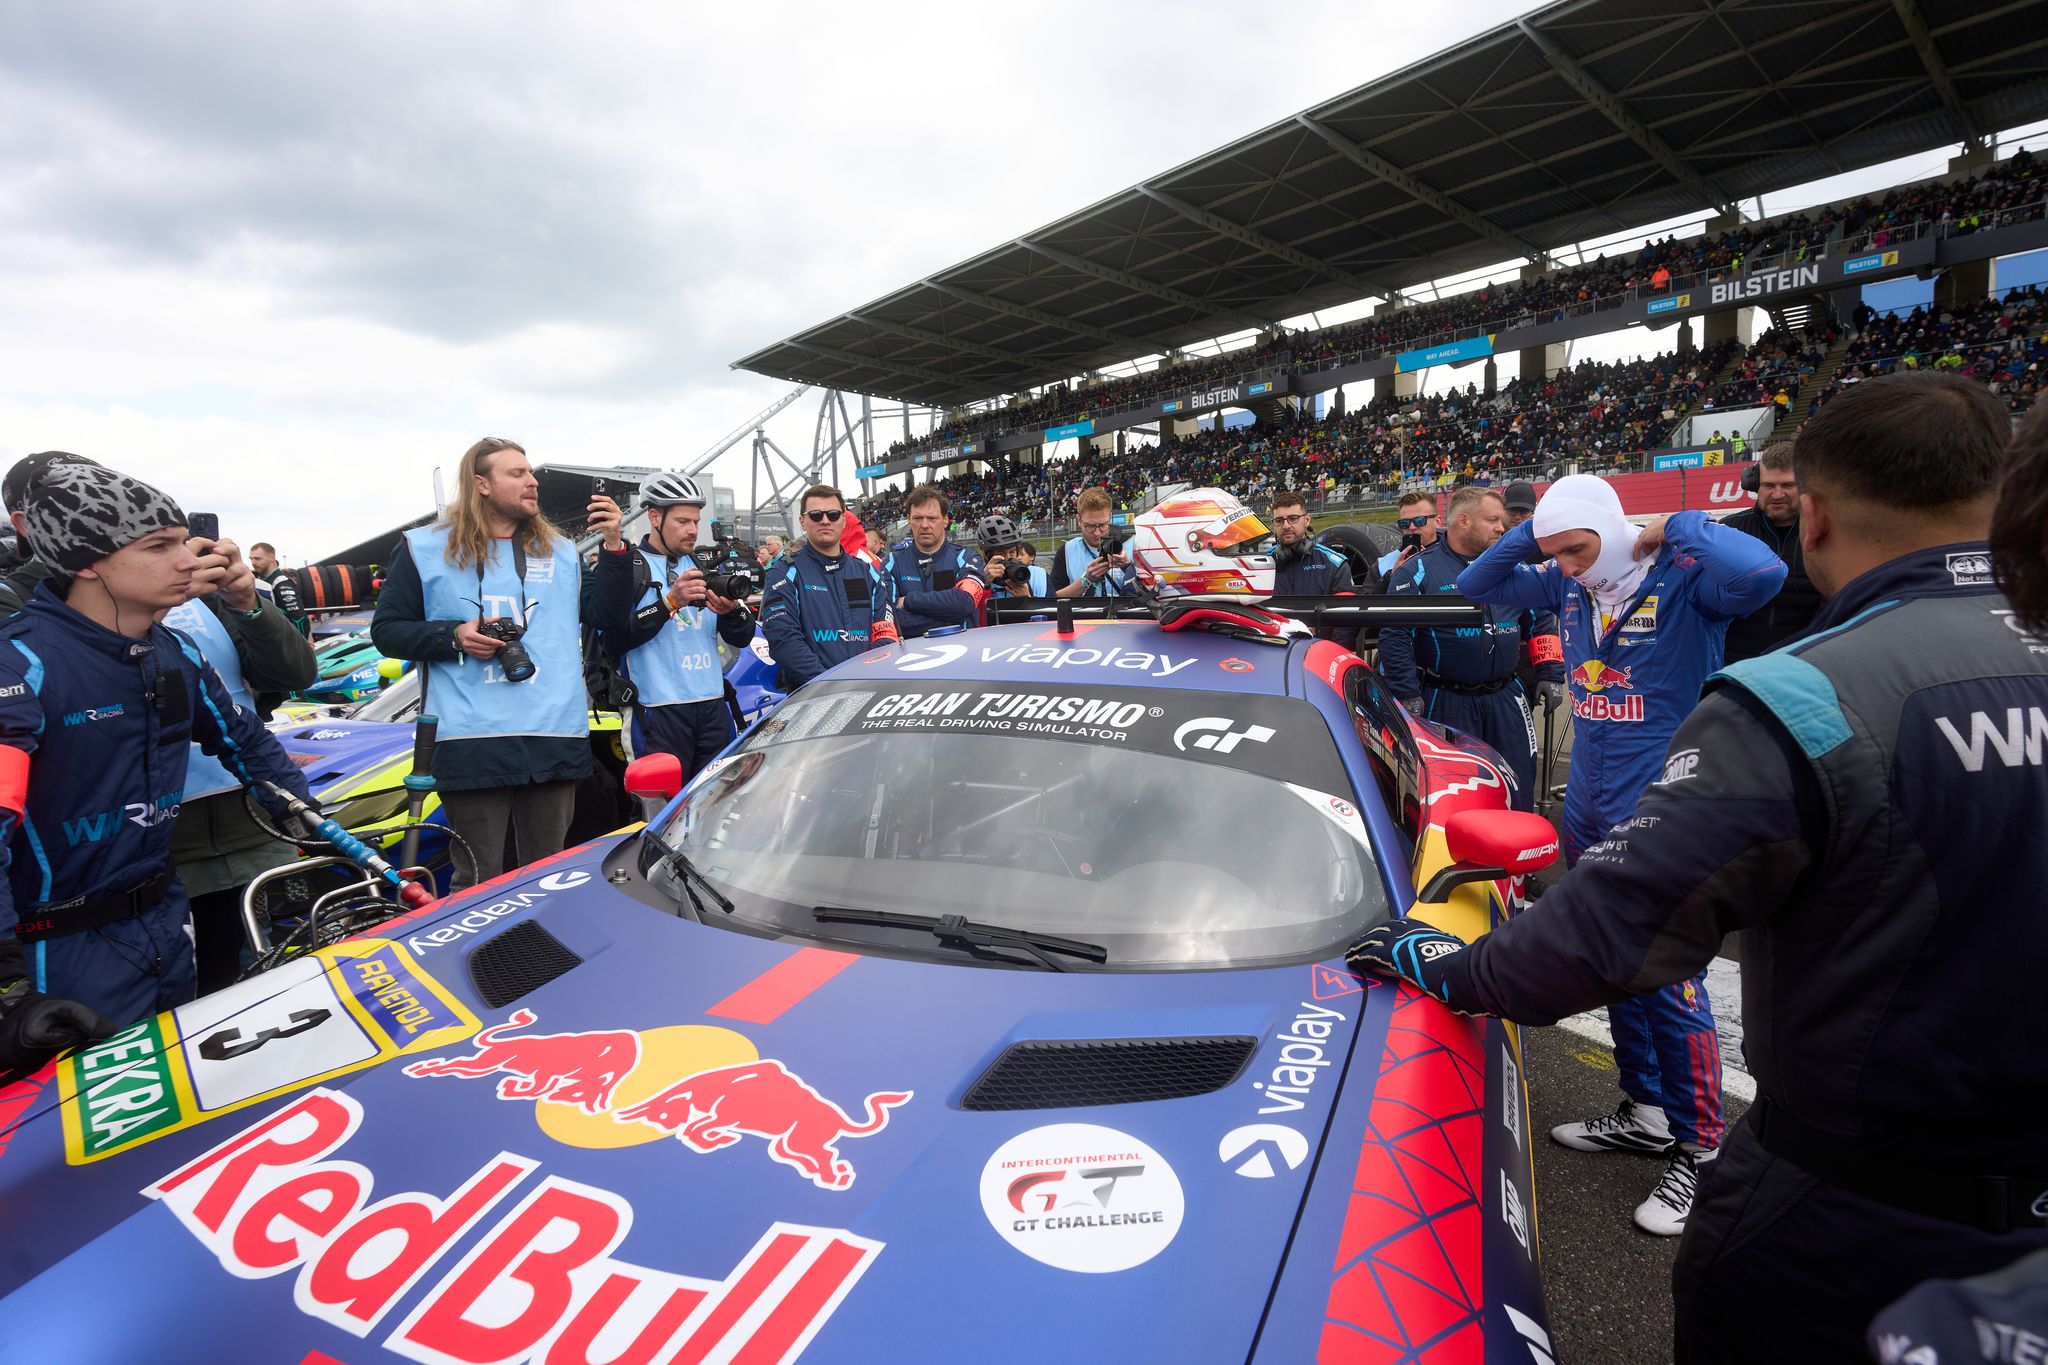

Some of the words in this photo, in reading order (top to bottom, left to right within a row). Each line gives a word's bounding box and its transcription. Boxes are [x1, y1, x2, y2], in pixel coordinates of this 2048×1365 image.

[1848, 258, 1879, 271] BILSTEIN
[1711, 264, 1819, 304] BILSTEIN
[1651, 300, 1675, 311] BILSTEIN
[1191, 387, 1239, 409] BILSTEIN
[931, 447, 959, 461] BILSTEIN
[1659, 457, 1698, 469] BILSTEIN
[1228, 580, 1245, 588] BELL
[681, 652, 712, 671] 420
[977, 643, 1199, 678] viaplay
[1538, 644, 1552, 652] 24h
[867, 692, 971, 718] GRAN
[1568, 690, 1592, 719] Red
[1590, 694, 1644, 722] Bull
[861, 719, 893, 730] THE
[895, 718, 937, 729] REAL
[939, 718, 1012, 732] DRIVING
[1015, 721, 1127, 742] SIMULATOR
[1521, 699, 1537, 751] RAVENOL
[1662, 754, 1699, 782] OMP
[15, 919, 55, 934] EDEL
[409, 891, 548, 957] viaplay
[354, 958, 434, 1034] RAVENOL
[198, 1007, 332, 1061] 3
[1253, 1001, 1346, 1115] viaplay
[79, 1022, 171, 1151] DEKRA
[1506, 1064, 1517, 1136] RAVENOL
[1001, 1152, 1143, 1169] INTERCONTINENTAL
[1007, 1165, 1145, 1213] GT
[1013, 1219, 1039, 1232] GT
[1045, 1210, 1164, 1230] CHALLENGE
[1505, 1177, 1528, 1249] OMP
[145, 1090, 535, 1330] Red
[390, 1178, 882, 1365] Bull
